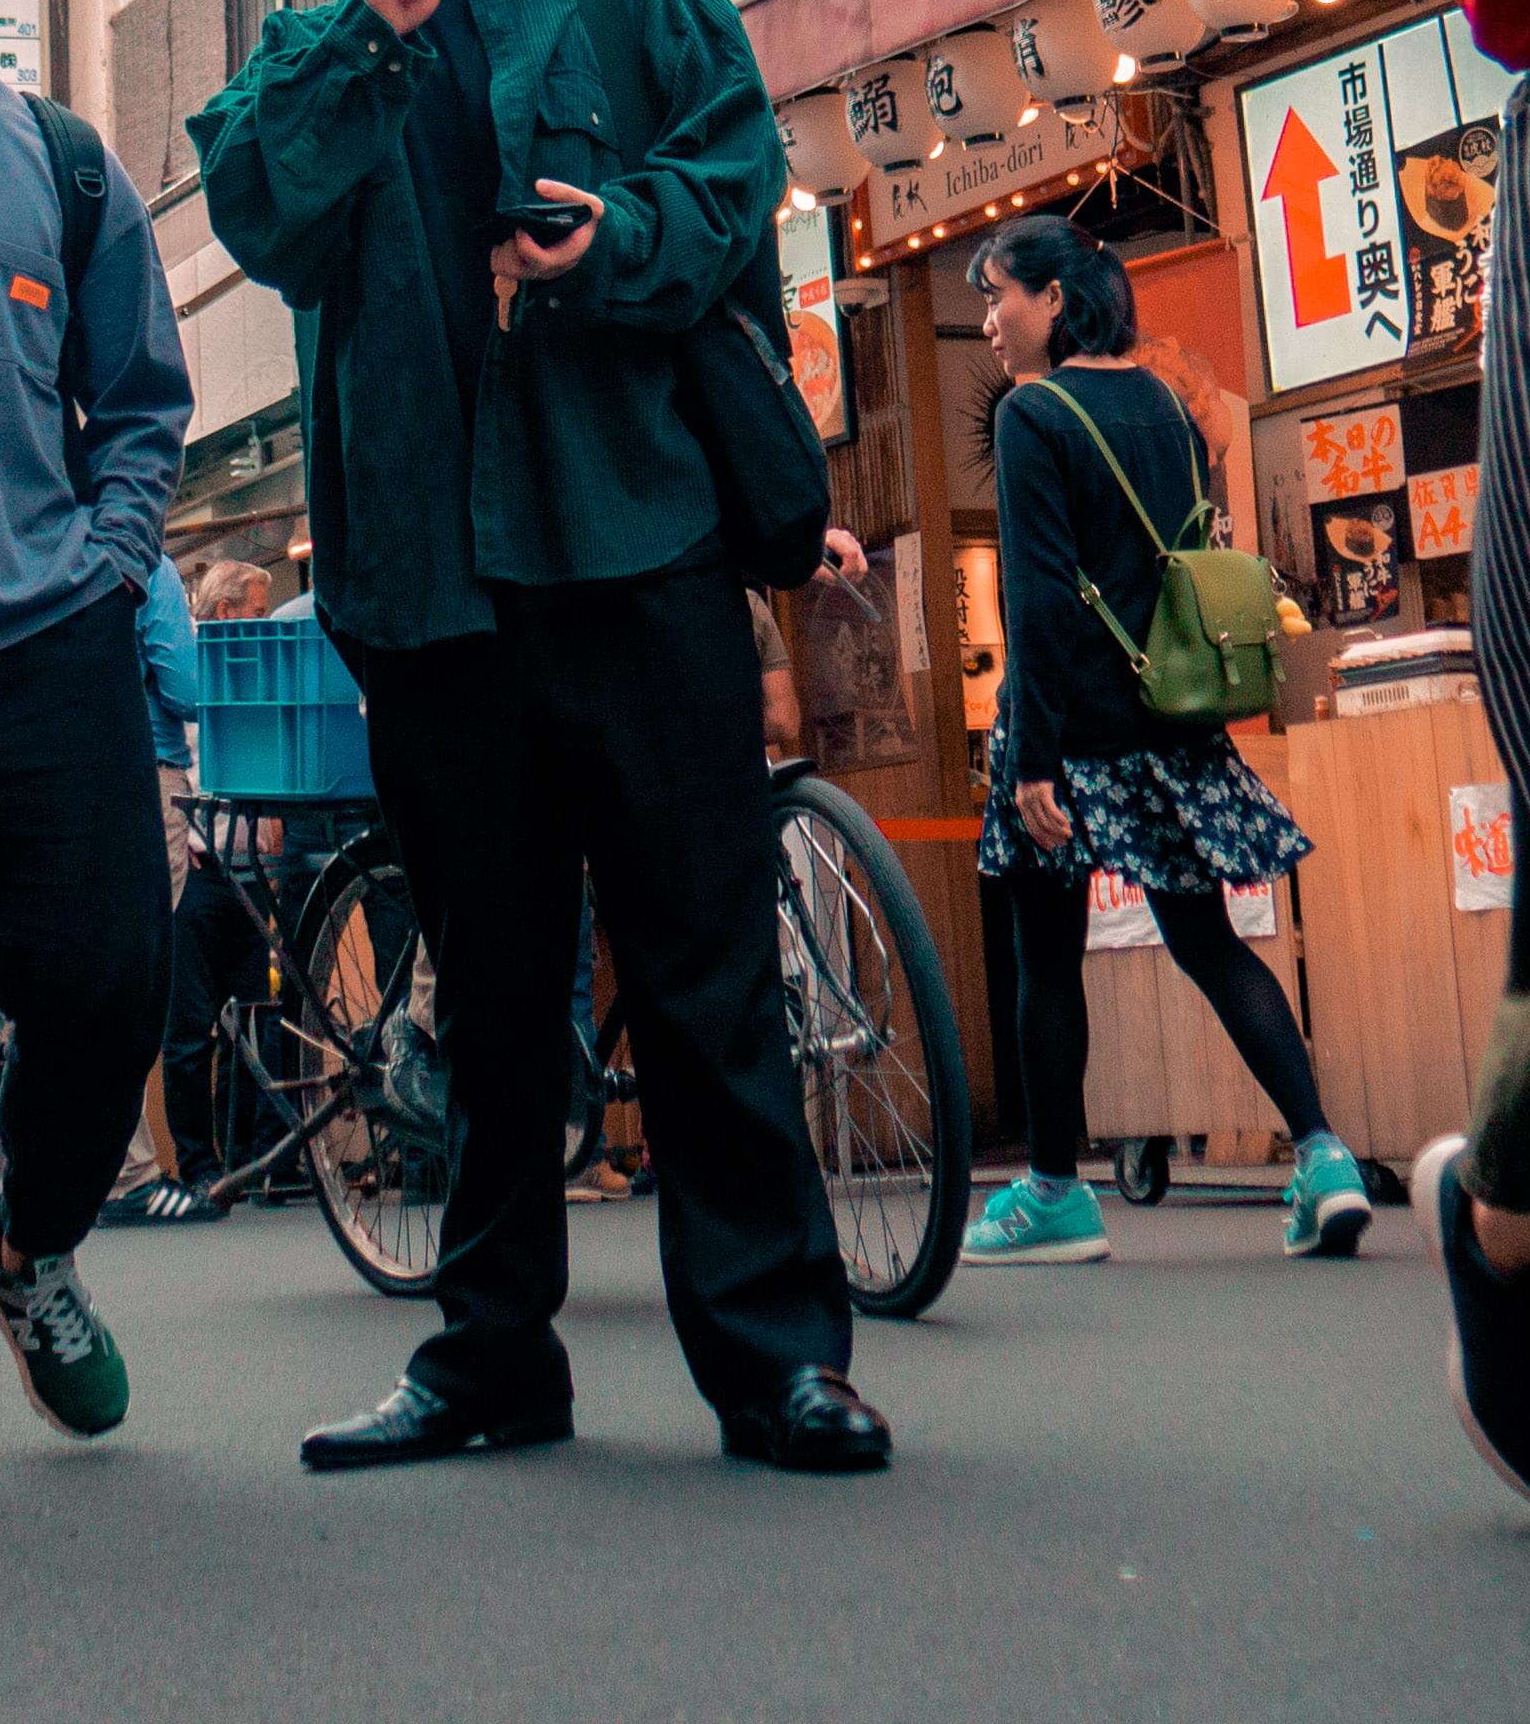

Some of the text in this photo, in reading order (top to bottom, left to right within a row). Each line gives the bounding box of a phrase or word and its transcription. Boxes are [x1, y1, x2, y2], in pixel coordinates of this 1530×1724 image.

[17, 23, 37, 36] 401
[16, 68, 38, 82] 303
[945, 134, 1045, 198] Ichiba-dōri
[1337, 60, 1404, 342] 市場通り奥へ
[1306, 415, 1397, 465] 本日の
[1321, 446, 1394, 500] 和牛
[1418, 505, 1468, 552] A4
